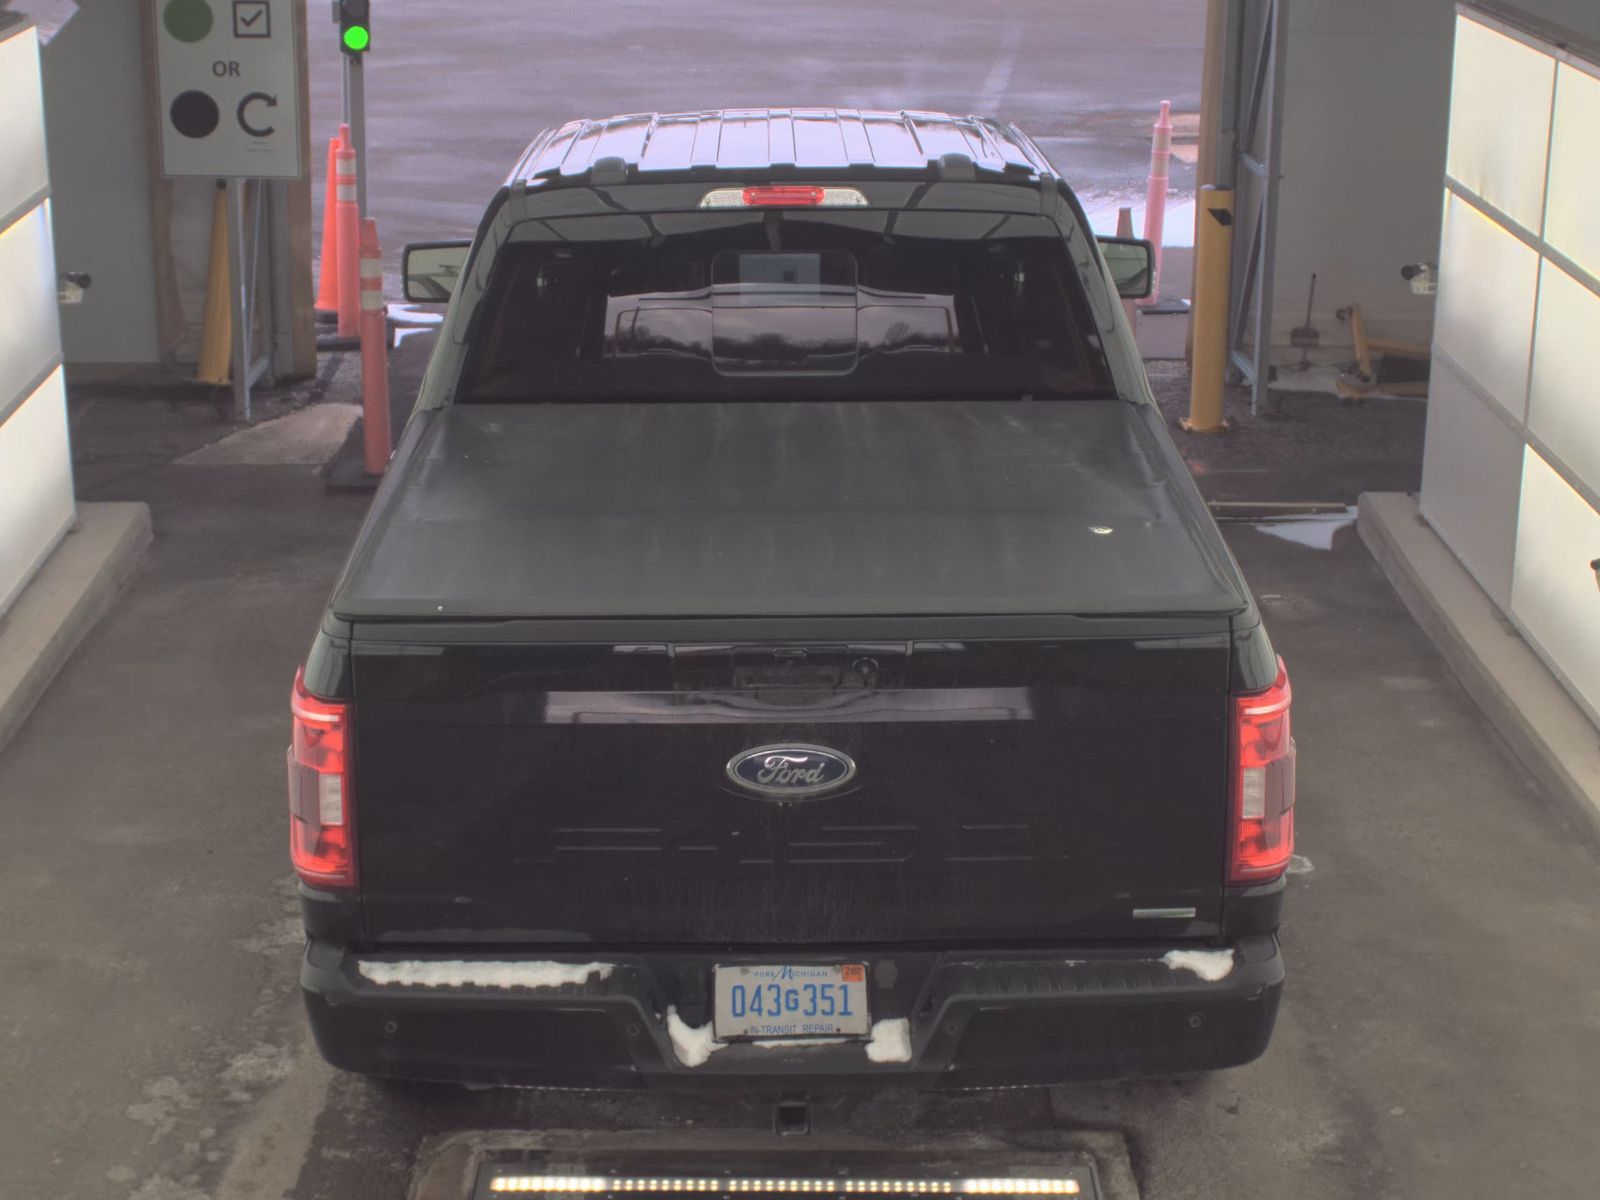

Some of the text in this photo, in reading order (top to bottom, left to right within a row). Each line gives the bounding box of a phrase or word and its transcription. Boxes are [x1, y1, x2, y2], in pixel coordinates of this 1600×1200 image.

[212, 60, 241, 77] OR
[757, 755, 826, 784] Ford
[773, 966, 828, 980] MICHIGAN
[731, 983, 853, 1018] 043G351
[802, 1023, 834, 1033] REPAIR
